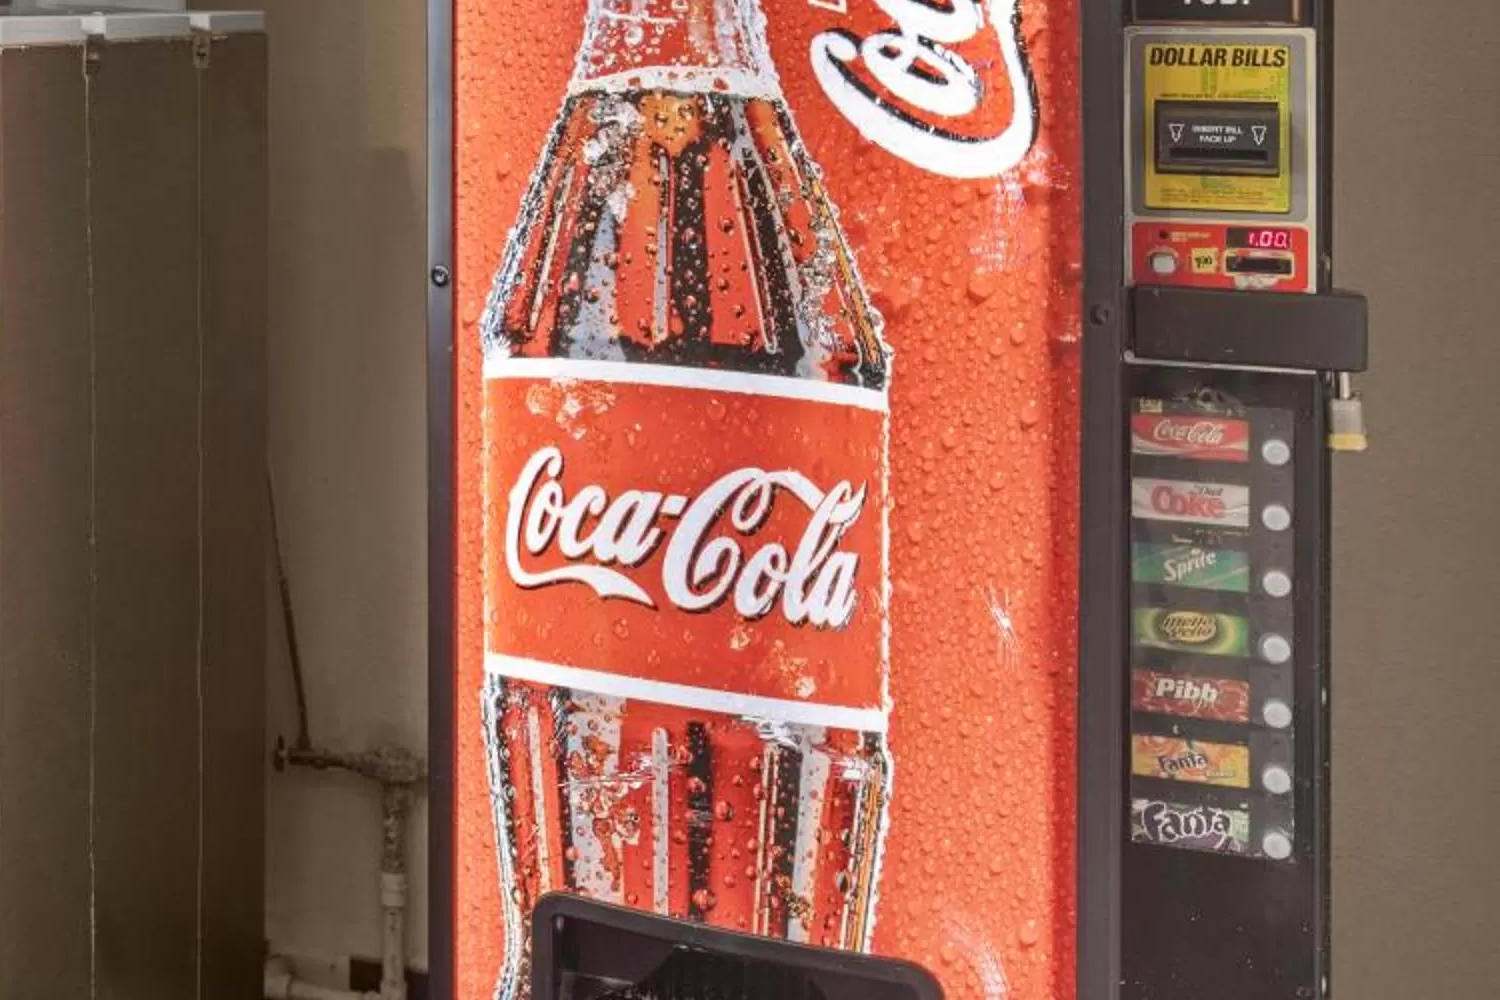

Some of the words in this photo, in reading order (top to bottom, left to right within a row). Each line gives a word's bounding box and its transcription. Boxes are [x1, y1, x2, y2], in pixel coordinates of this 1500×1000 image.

[1150, 47, 1227, 67] DOLLAR
[1231, 48, 1286, 68] BILLS
[1154, 418, 1225, 446] Coca-Cola
[1151, 484, 1226, 519] Coke
[506, 446, 867, 629] Coca-Cola
[1163, 548, 1217, 582] Sprite
[1155, 677, 1218, 703] Pibb
[1156, 751, 1209, 774] Fanta
[1141, 801, 1232, 843] Fanta
